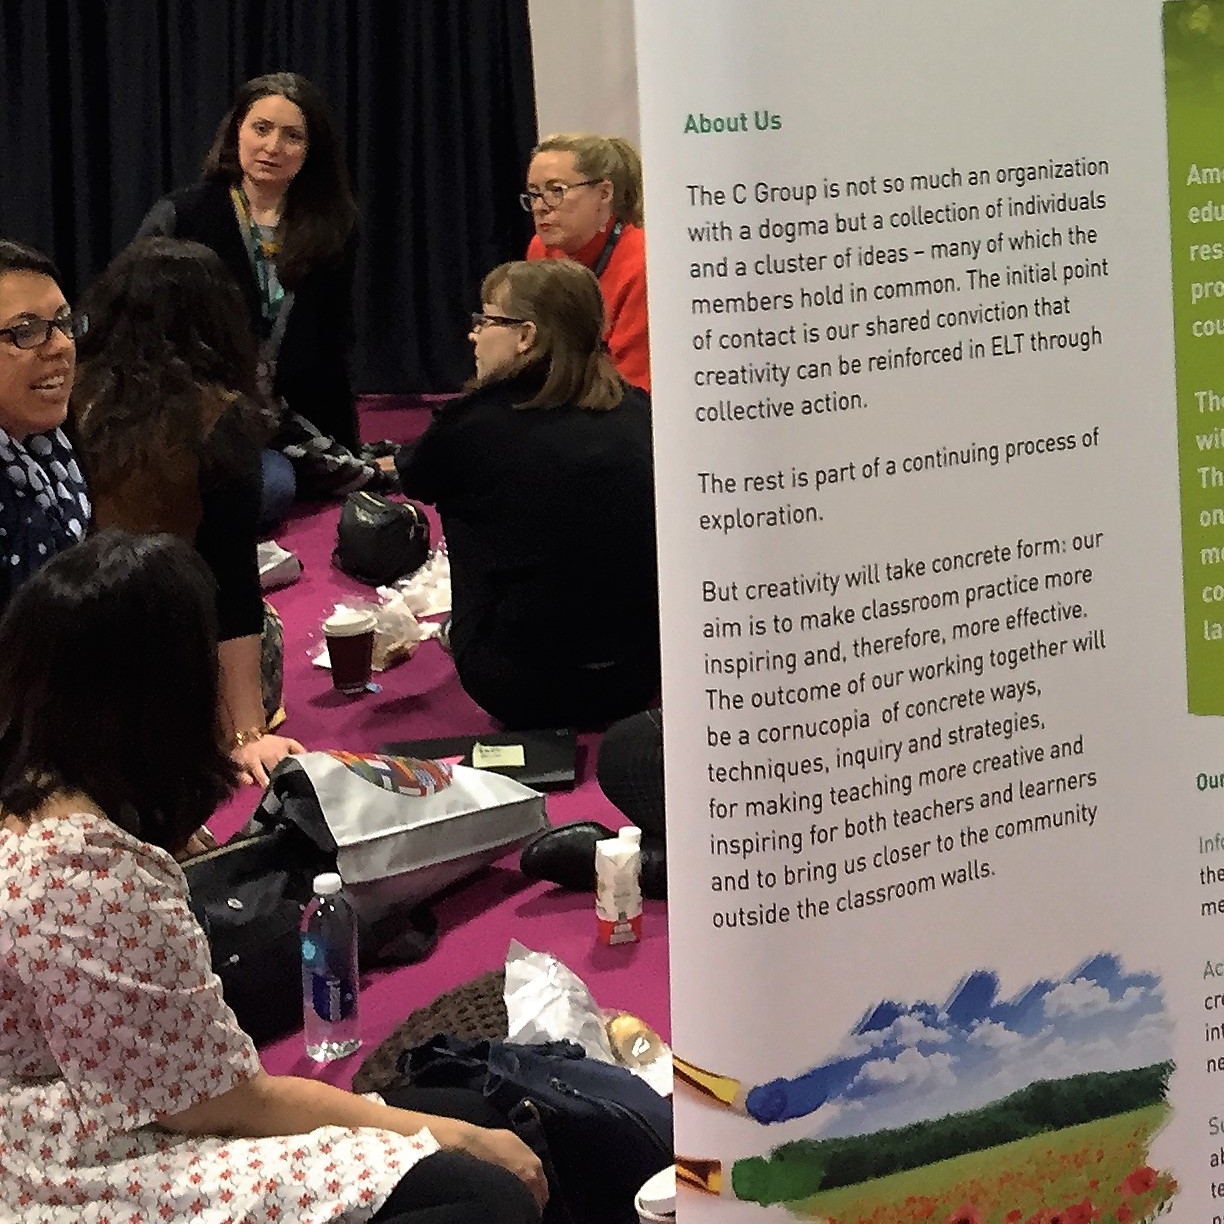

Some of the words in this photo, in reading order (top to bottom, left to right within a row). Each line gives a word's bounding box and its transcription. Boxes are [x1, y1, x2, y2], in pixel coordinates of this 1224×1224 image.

[683, 112, 749, 135] About
[753, 109, 783, 132] Us
[686, 184, 727, 207] The
[732, 182, 748, 205] C
[753, 181, 818, 206] Group
[822, 177, 841, 199] is
[845, 175, 878, 197] not
[882, 177, 905, 194] so
[909, 166, 963, 192] much
[967, 169, 991, 187] an
[995, 156, 1110, 188] organization
[691, 290, 794, 315] members
[799, 282, 844, 309] hold
[849, 282, 868, 304] in
[873, 277, 961, 301] common.
[965, 268, 1001, 291] The
[1005, 260, 1058, 286] initial
[1062, 257, 1109, 287] point
[694, 396, 795, 423] collective
[800, 390, 868, 416] action.
[701, 580, 739, 603] But
[745, 570, 841, 601] creativity
[844, 562, 879, 588] will
[885, 557, 926, 582] take
[931, 544, 1012, 574] concrete
[1016, 538, 1067, 560] form:
[1071, 532, 1104, 552] our
[704, 648, 797, 677] inspiring
[803, 640, 848, 668] and,
[851, 627, 947, 659] therefore,
[951, 617, 1001, 641] more
[1005, 600, 1088, 631] effective.
[707, 756, 830, 784] techniques,
[836, 735, 903, 769] inquiry
[908, 726, 942, 755] and
[947, 711, 1046, 746] strategies,
[712, 902, 791, 929] outside
[796, 896, 830, 918] the
[835, 876, 936, 911] classroom
[940, 858, 996, 888] walls.
